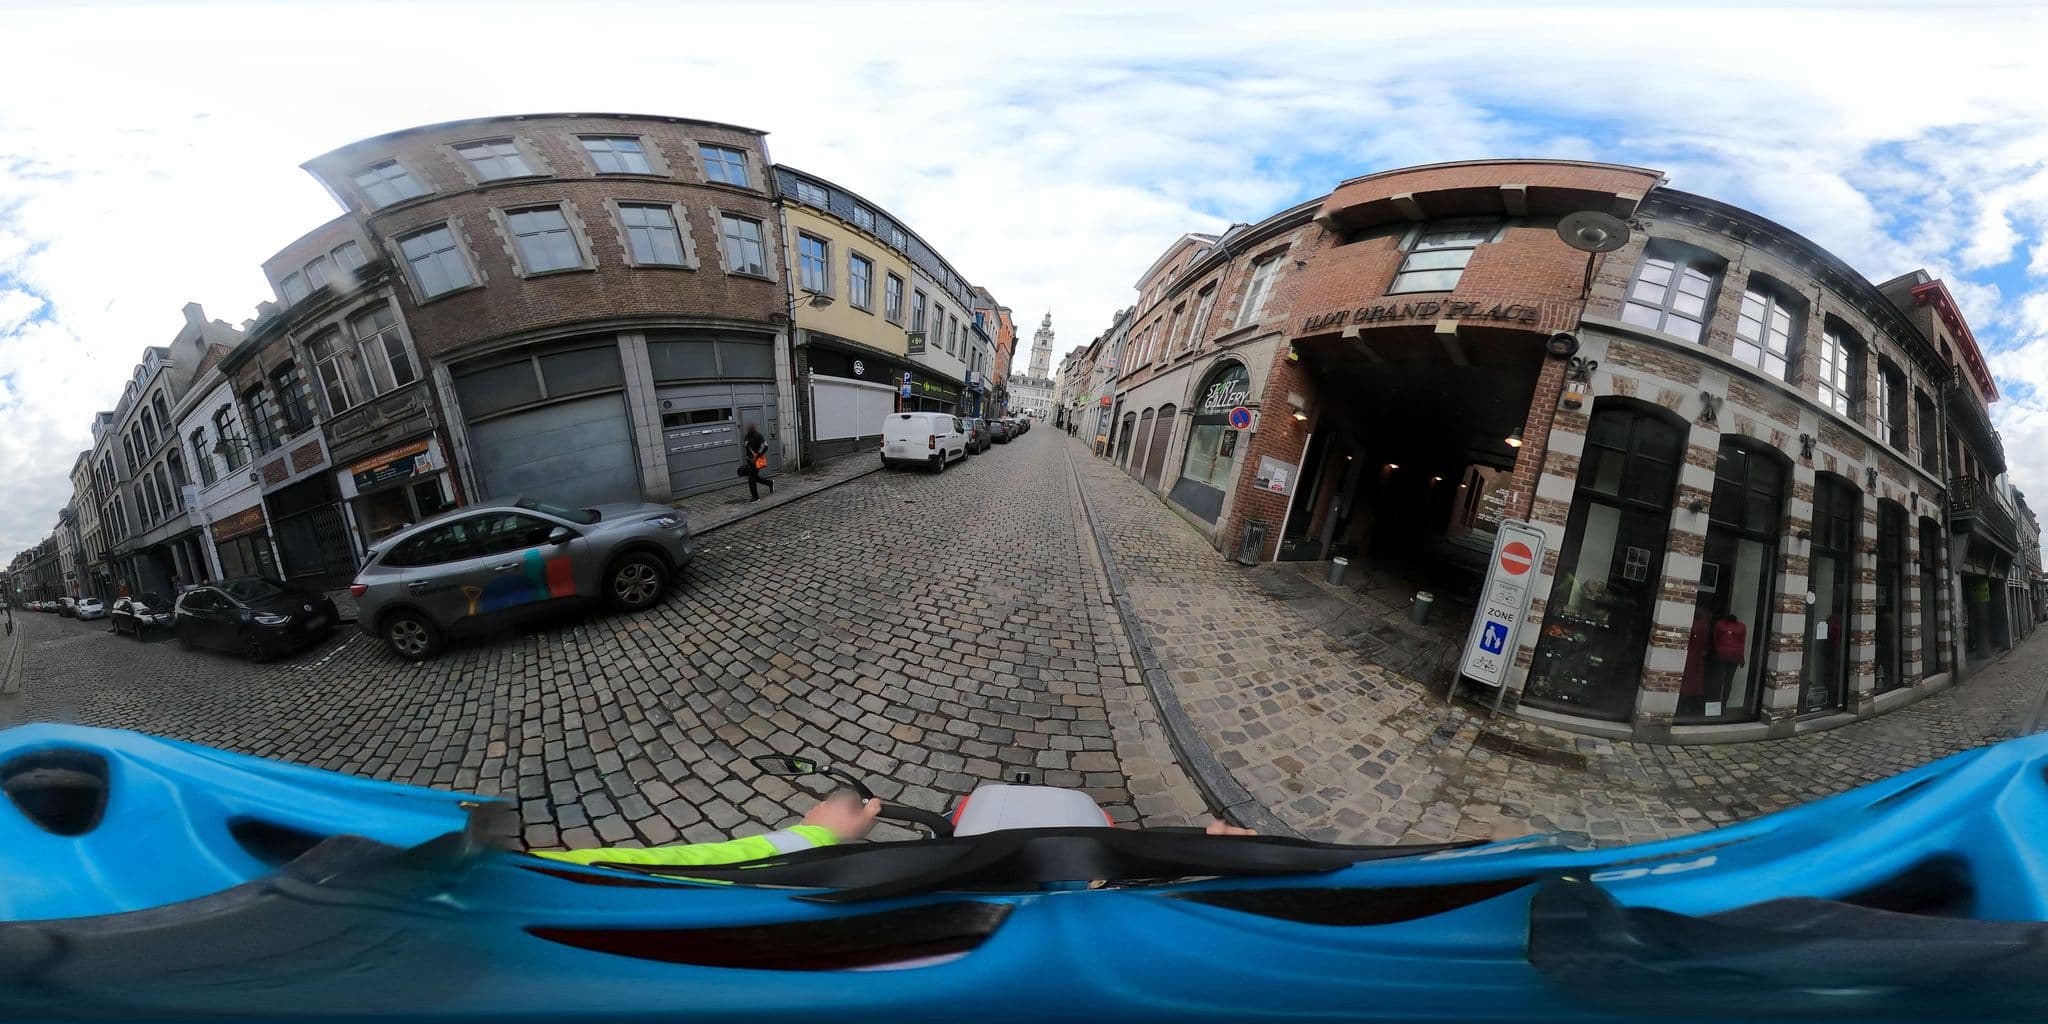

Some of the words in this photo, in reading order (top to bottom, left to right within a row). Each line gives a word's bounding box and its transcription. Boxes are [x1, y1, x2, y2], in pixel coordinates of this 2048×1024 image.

[1302, 309, 1350, 331] ILOT
[904, 372, 911, 382] P
[1204, 391, 1250, 408] GALLERY
[1488, 607, 1514, 621] ZONE
